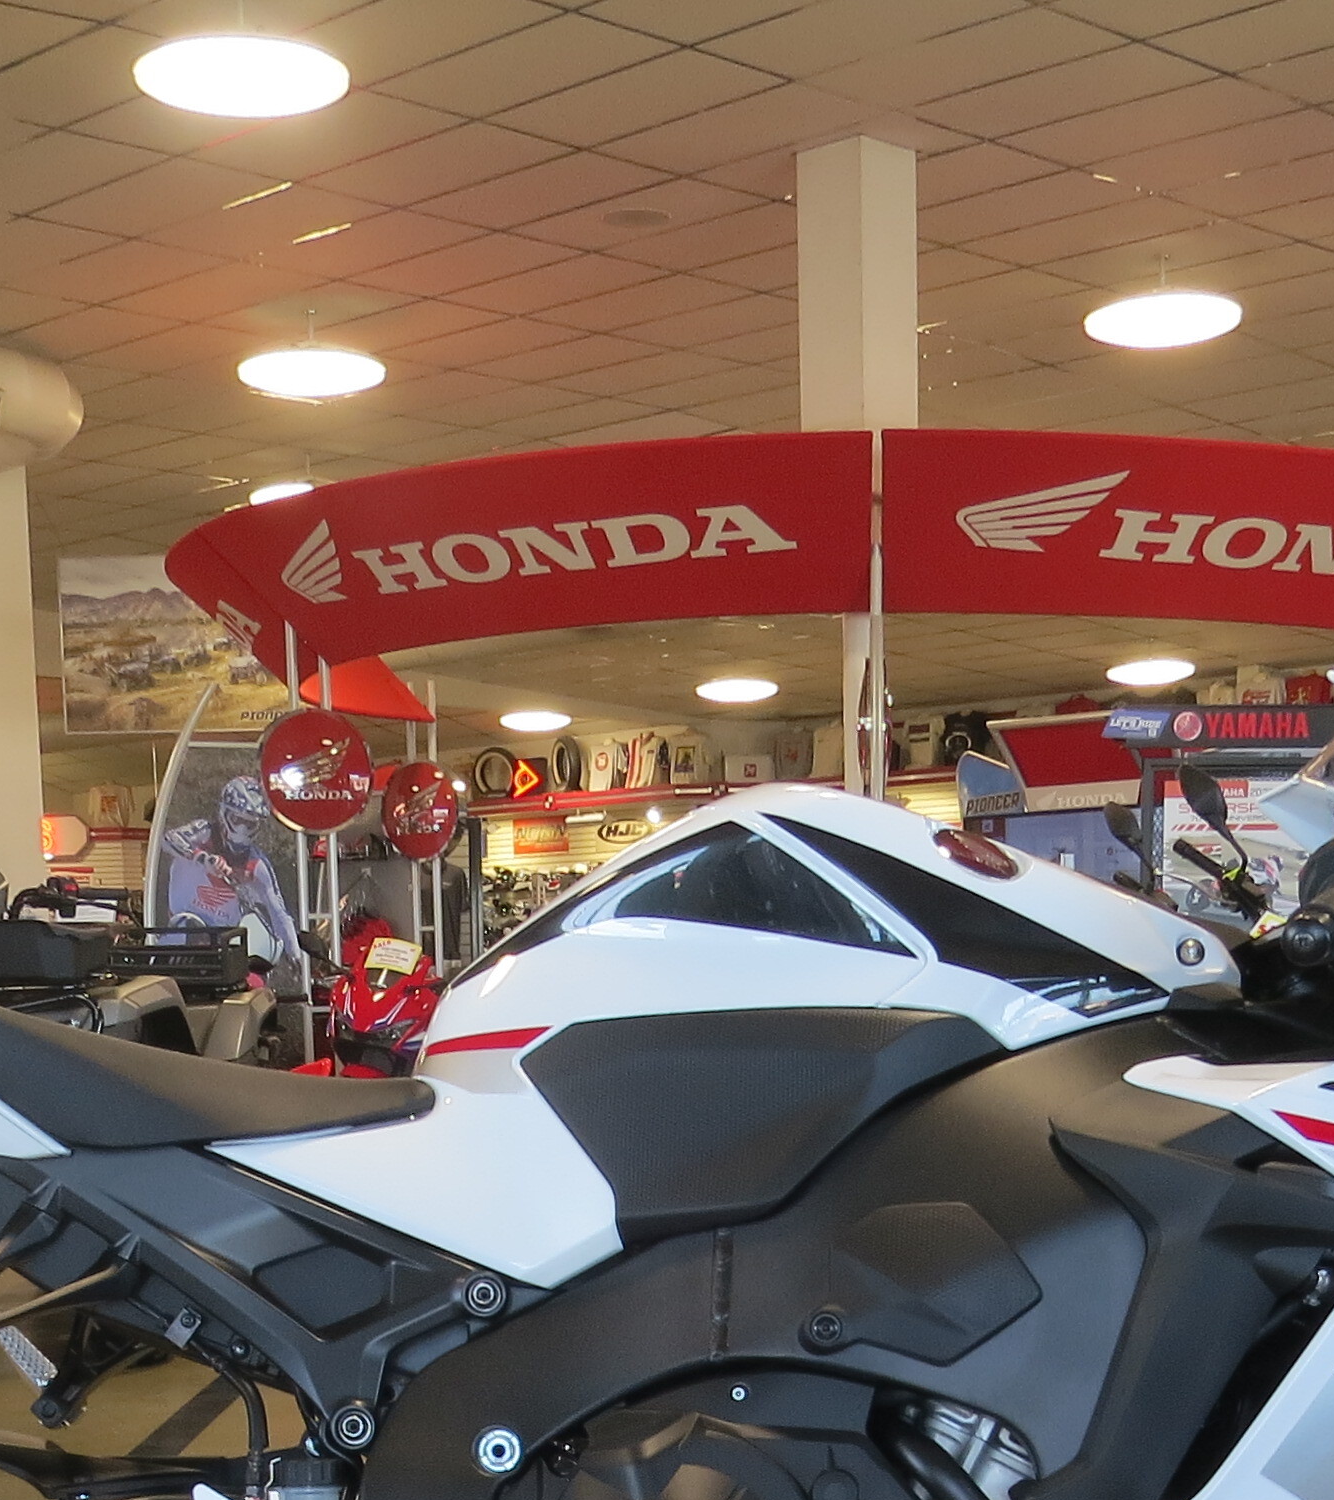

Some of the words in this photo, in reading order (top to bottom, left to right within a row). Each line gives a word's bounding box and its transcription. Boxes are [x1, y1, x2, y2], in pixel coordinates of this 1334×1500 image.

[349, 504, 798, 596] HONDA
[1204, 711, 1310, 740] YAMAHA
[285, 788, 355, 801] HONDA
[966, 793, 1021, 814] PIONEER
[1056, 792, 1129, 808] HONDA
[604, 822, 646, 839] HJC
